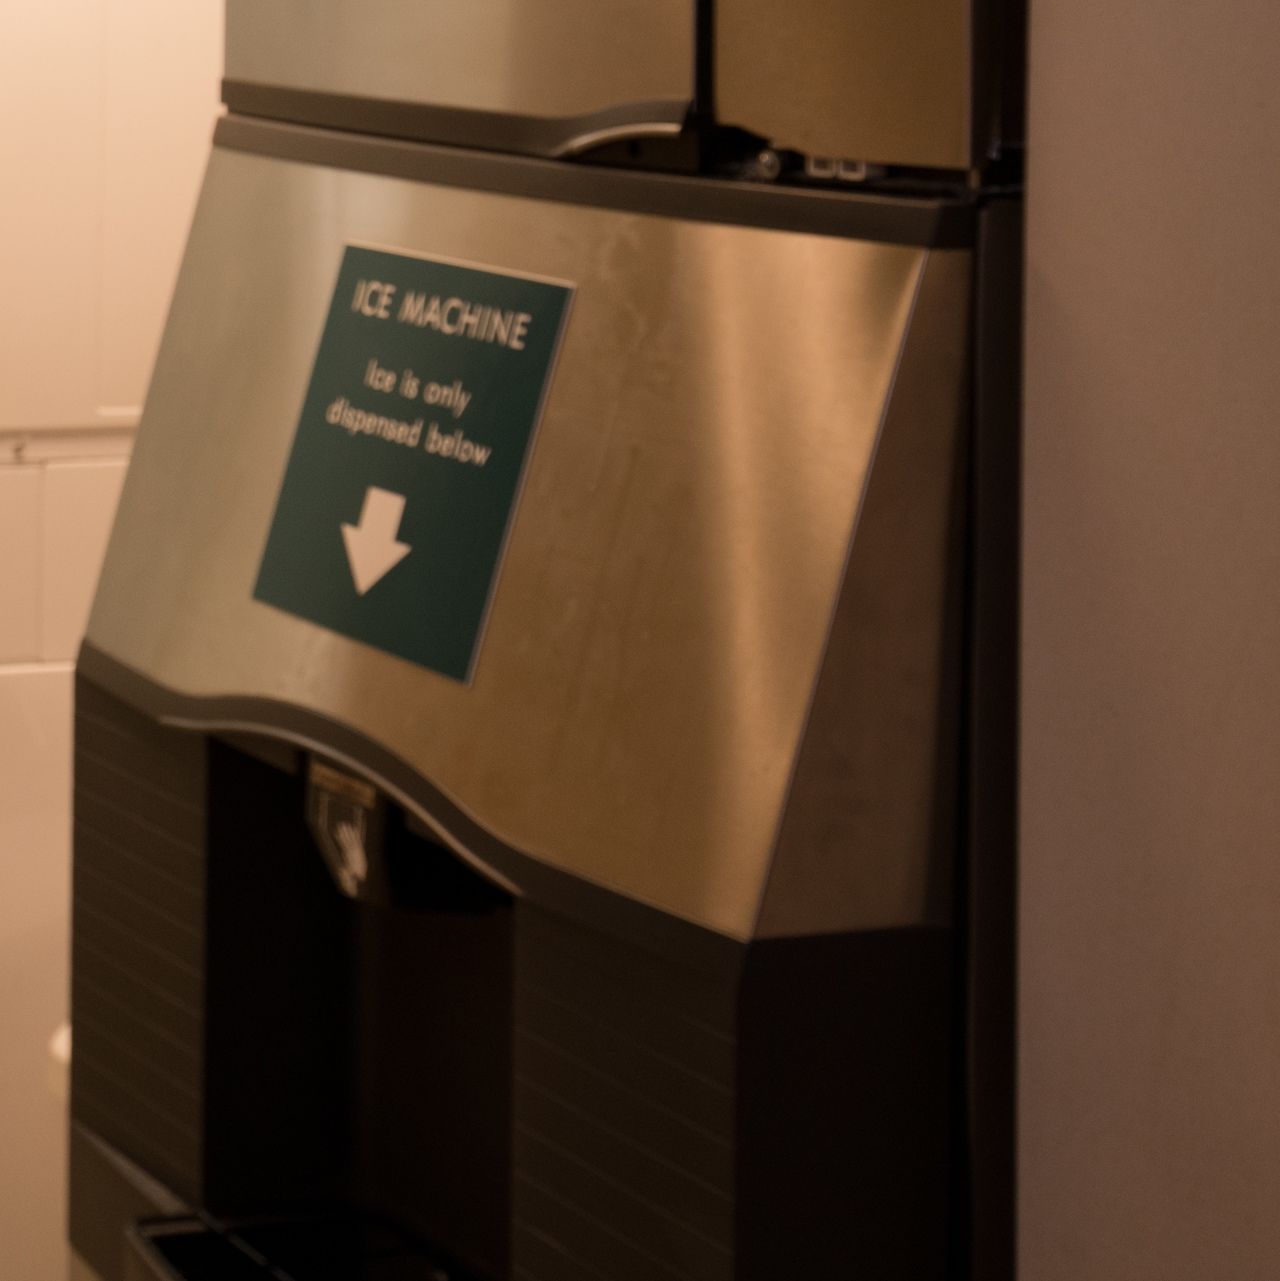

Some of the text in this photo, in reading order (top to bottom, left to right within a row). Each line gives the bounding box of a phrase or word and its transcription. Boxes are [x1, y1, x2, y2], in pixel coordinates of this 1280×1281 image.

[353, 281, 531, 349] ICE MACHINE
[366, 360, 471, 416] Ice is only
[326, 394, 490, 464] dispensed below
